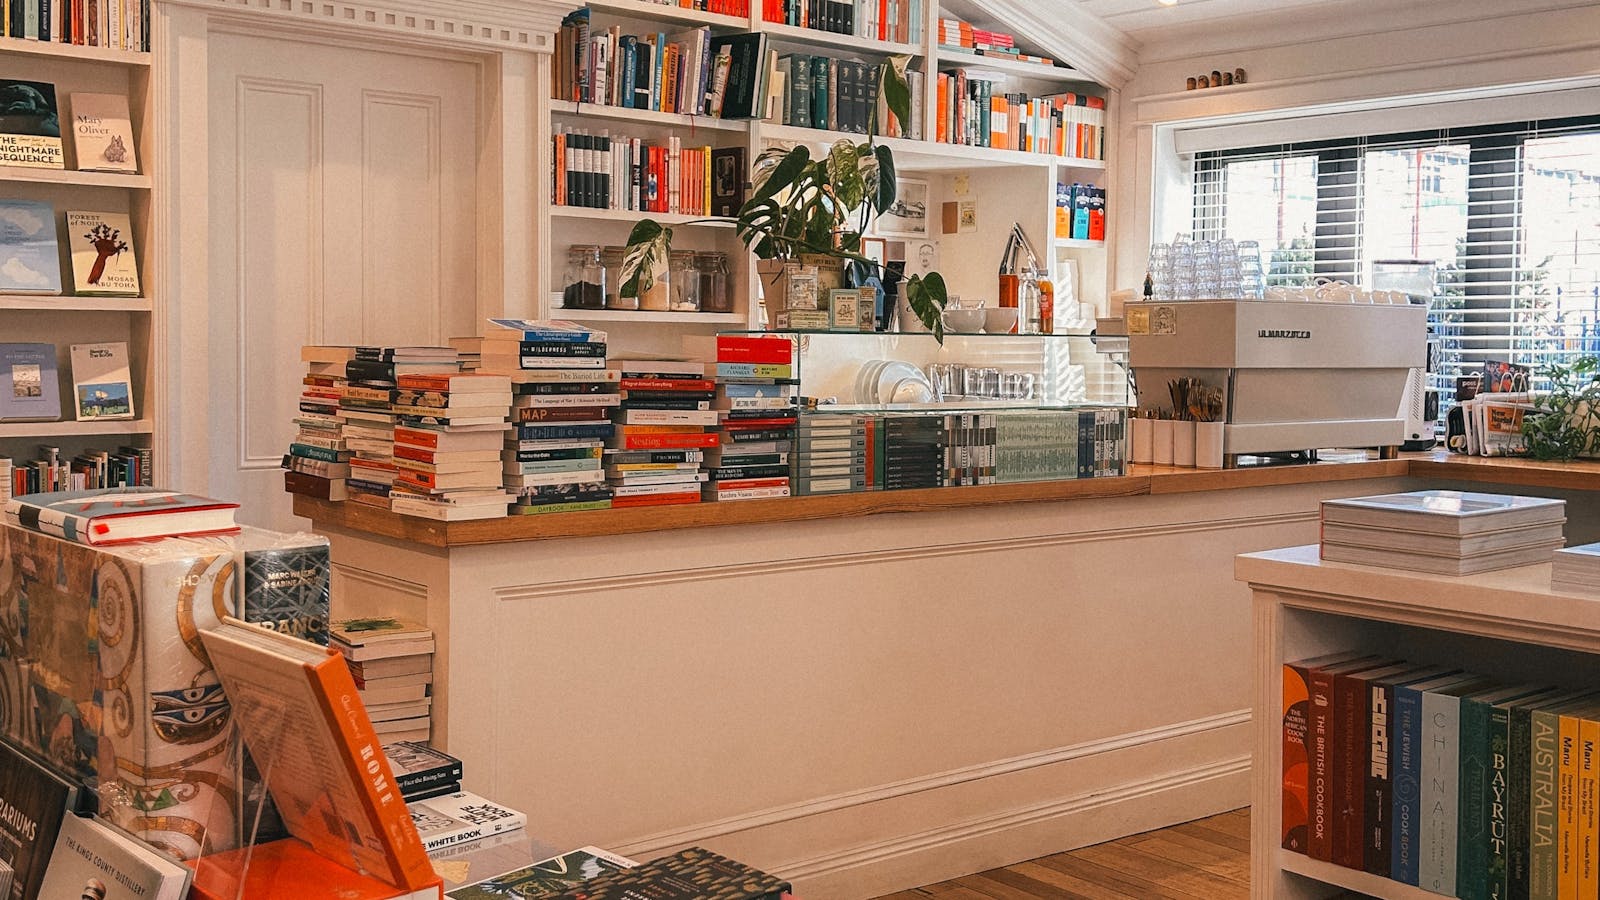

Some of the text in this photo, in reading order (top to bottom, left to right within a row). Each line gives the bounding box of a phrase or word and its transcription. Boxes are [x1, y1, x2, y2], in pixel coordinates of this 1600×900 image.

[77, 116, 103, 125] Mary
[79, 125, 110, 134] Oliver
[522, 408, 548, 420] MAP
[1403, 710, 1411, 729] THE
[1402, 730, 1410, 770] JEWISH
[1432, 712, 1446, 816] CHINA
[1563, 737, 1572, 766] Manu
[1584, 741, 1593, 770] Manu
[360, 744, 394, 806] ROME
[404, 778, 414, 788] Face
[1316, 715, 1325, 840] THE BRITISH COOKBOOK
[1534, 720, 1554, 848] AUSTRALIA
[428, 830, 482, 849] WHITE BOOK
[66, 836, 146, 897] THE KINGS COUNTY DISTILLERY
